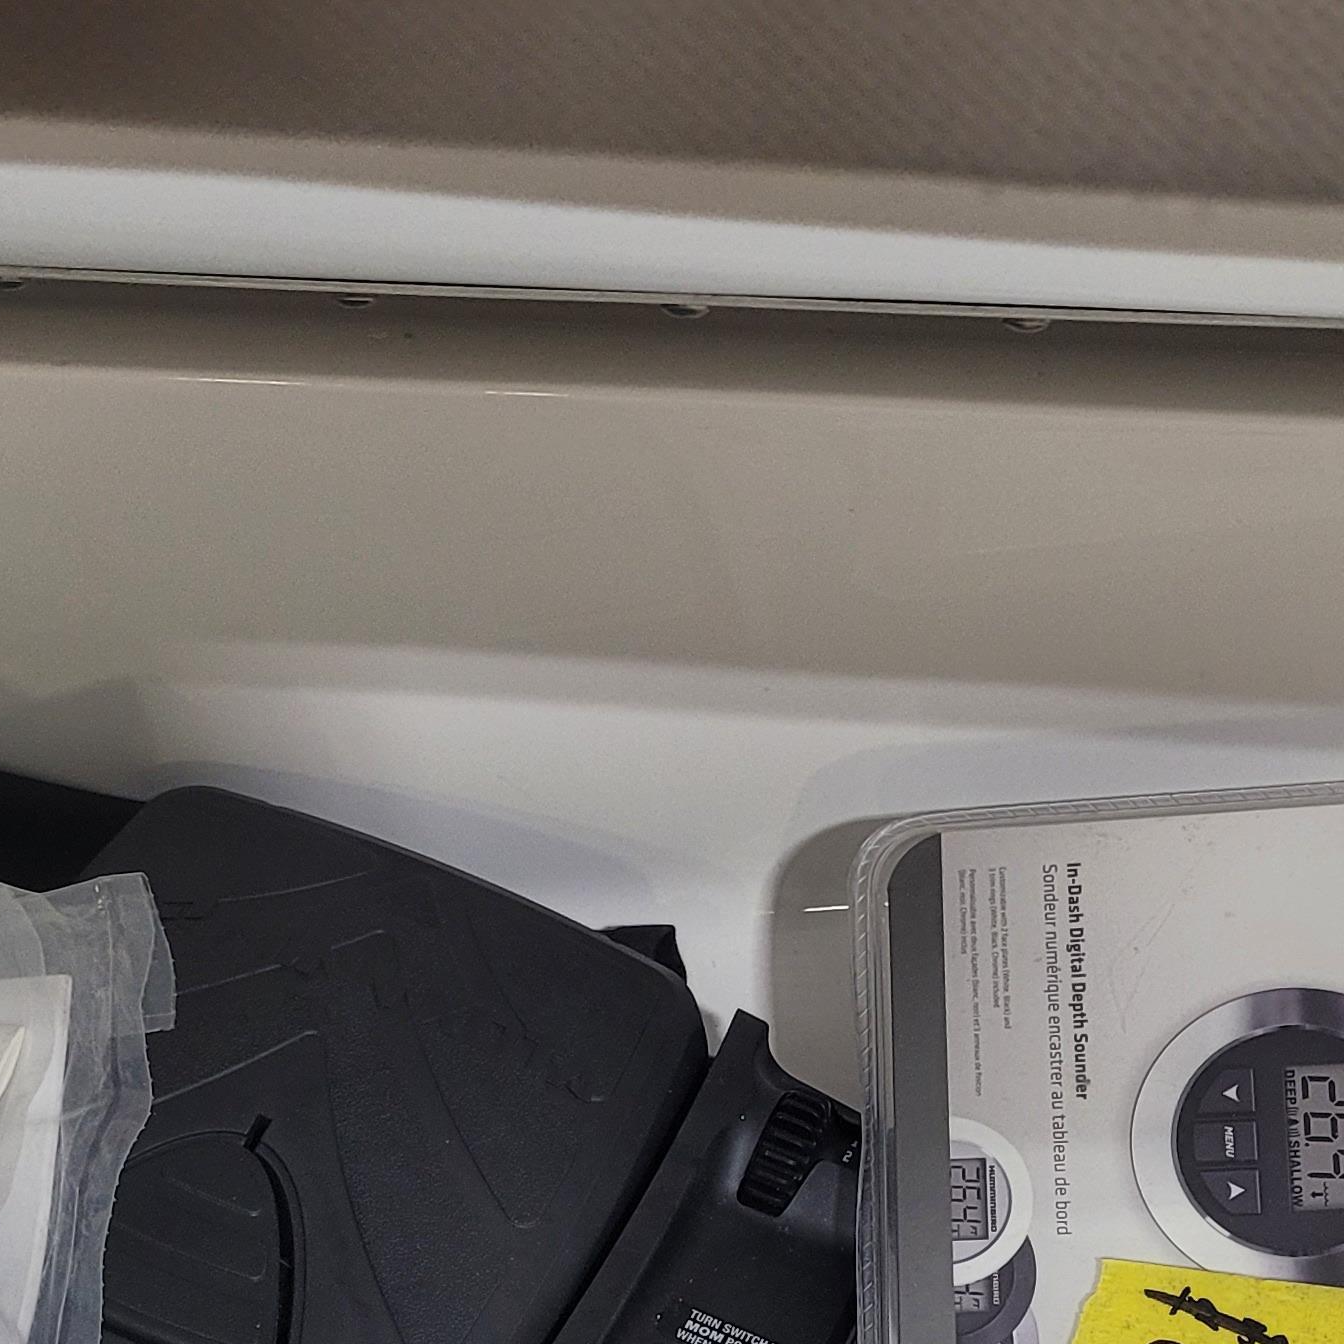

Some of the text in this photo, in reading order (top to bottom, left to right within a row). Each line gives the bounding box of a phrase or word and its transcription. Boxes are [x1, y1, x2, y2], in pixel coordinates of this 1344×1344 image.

[1066, 862, 1090, 1100] In-Dash Digital Depth Sounder
[1043, 864, 1072, 1236] Sondeur numérique encastrer au tableau de bord
[1223, 1125, 1236, 1158] MENU
[1284, 1068, 1303, 1208] DEEP SHALLOW
[684, 1319, 725, 1344] MOM
[690, 1308, 722, 1330] TURN
